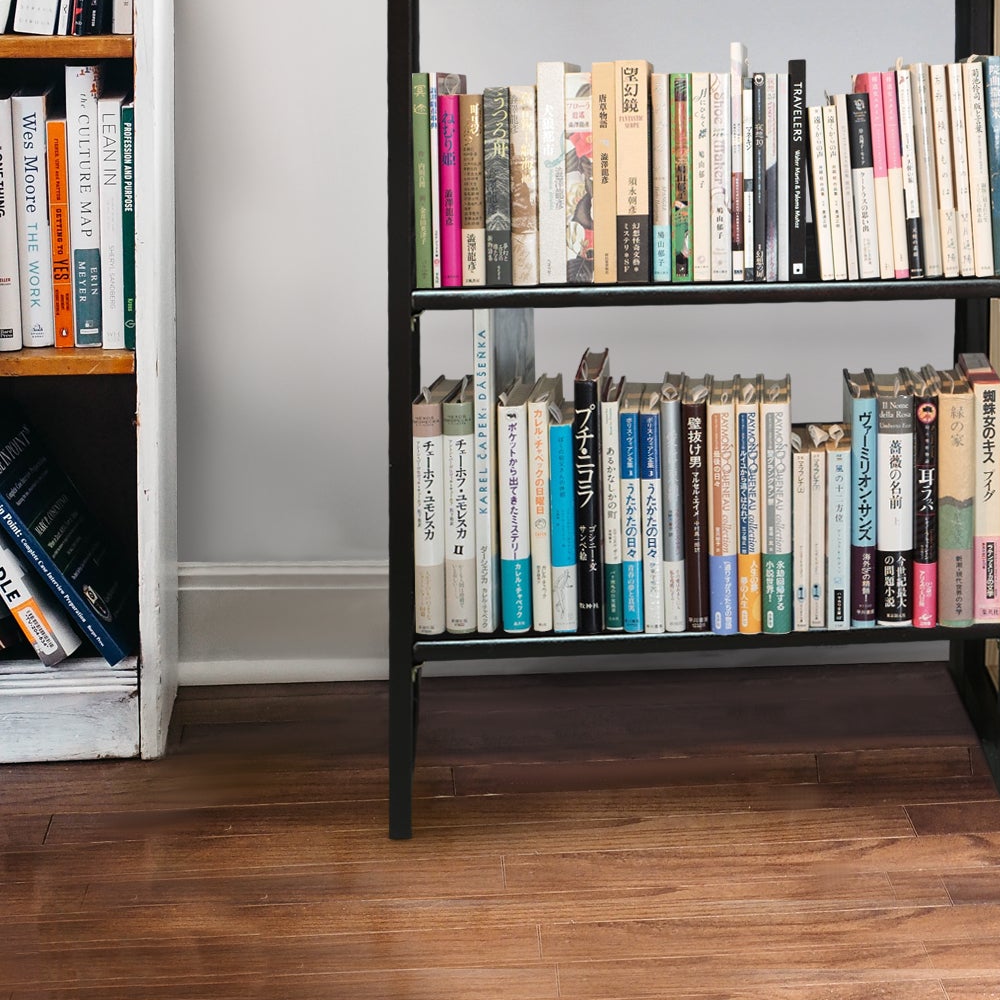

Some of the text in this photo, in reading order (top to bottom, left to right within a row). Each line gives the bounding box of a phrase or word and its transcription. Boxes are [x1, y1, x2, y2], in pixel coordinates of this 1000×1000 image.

[442, 110, 456, 166] ねむり姫
[492, 92, 509, 158] うつろ舟
[599, 94, 608, 128] 唐草物語
[793, 82, 803, 142] TRAVELERS
[78, 114, 92, 195] CULTURE
[102, 113, 117, 186] LEAN IN
[124, 122, 133, 212] PROFESSION AND PURPOSE
[22, 112, 40, 308] Wes Moore THE WORK
[80, 201, 93, 238] MAP
[53, 259, 70, 280] YES
[57, 245, 63, 255] TO
[78, 261, 87, 302] MEYER
[90, 267, 99, 295] ERIN
[879, 410, 912, 418] della Rosa
[881, 402, 909, 410] Il Nome
[950, 406, 965, 447] 緑の家
[982, 389, 996, 464] 蜘蛛女のキス
[533, 409, 545, 515] カレル・チャペックの日曜日
[575, 404, 596, 509] プチ・ニコラ
[626, 415, 634, 468] ボリス・ヴィアン全集
[647, 415, 655, 469] ボリス・ヴィアン全集
[687, 416, 702, 517] 壁抜け男 マルセル・エイメ
[422, 440, 435, 541] チェーホフ・ユモレスカ
[455, 438, 468, 540] チェーホフ・ユモレスカ
[479, 468, 489, 514] KAREL
[606, 446, 617, 519] あるかなしかの町
[740, 450, 748, 523] ルイユから遠くはなれて
[835, 464, 846, 523] 風の十二方位
[858, 411, 873, 541] ヴァーミリオン・サンズ
[888, 439, 902, 510] 薔薇の名前
[919, 467, 935, 512] 耳ラッパ
[507, 423, 522, 618] ポケットから出てきたミステリー カレル・チャペック
[578, 524, 588, 561] サンペ・絵
[588, 524, 597, 573] ゴシニー・文
[625, 484, 638, 558] うたかたの日々
[646, 484, 658, 558] うたかたの日々
[2, 513, 87, 623] Point: Complete Case Interview Preparation
[480, 545, 489, 584] ダーシェンカ
[776, 560, 785, 610] 永劫回帰する
[884, 555, 895, 608] の問題小説
[895, 555, 907, 608] 今世紀最大
[955, 555, 963, 616] 新潮・現代世界の文学
